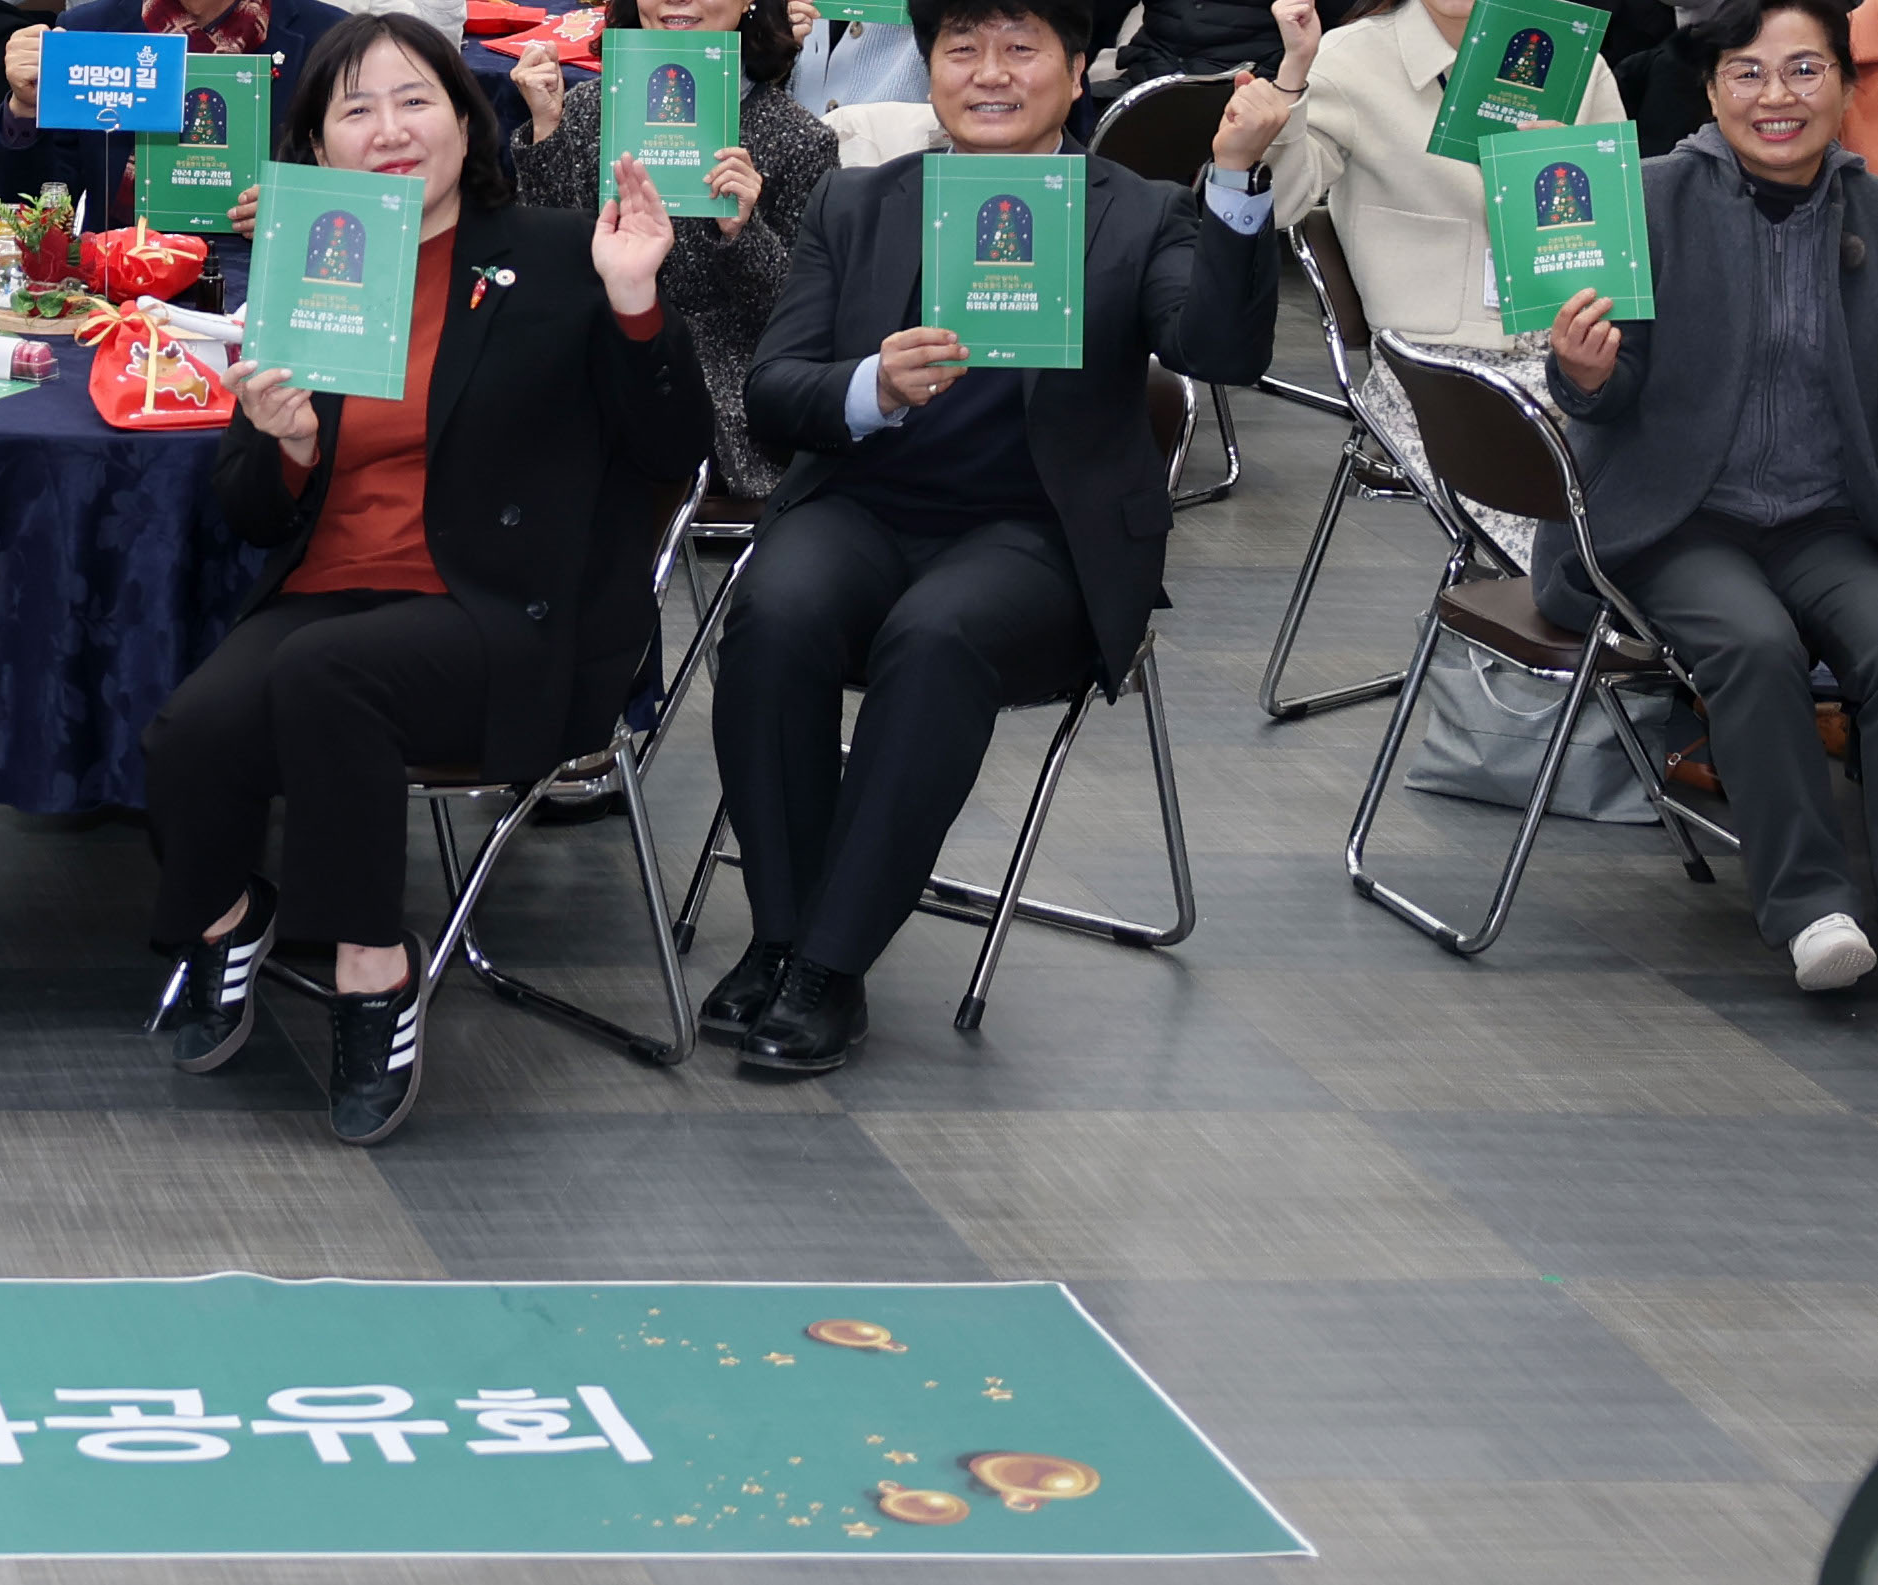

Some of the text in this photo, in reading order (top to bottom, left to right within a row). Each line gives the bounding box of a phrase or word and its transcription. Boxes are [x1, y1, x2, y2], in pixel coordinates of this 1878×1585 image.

[68, 66, 158, 89] 희망의 길
[88, 92, 133, 108] 내빈석
[967, 292, 990, 301] 2024
